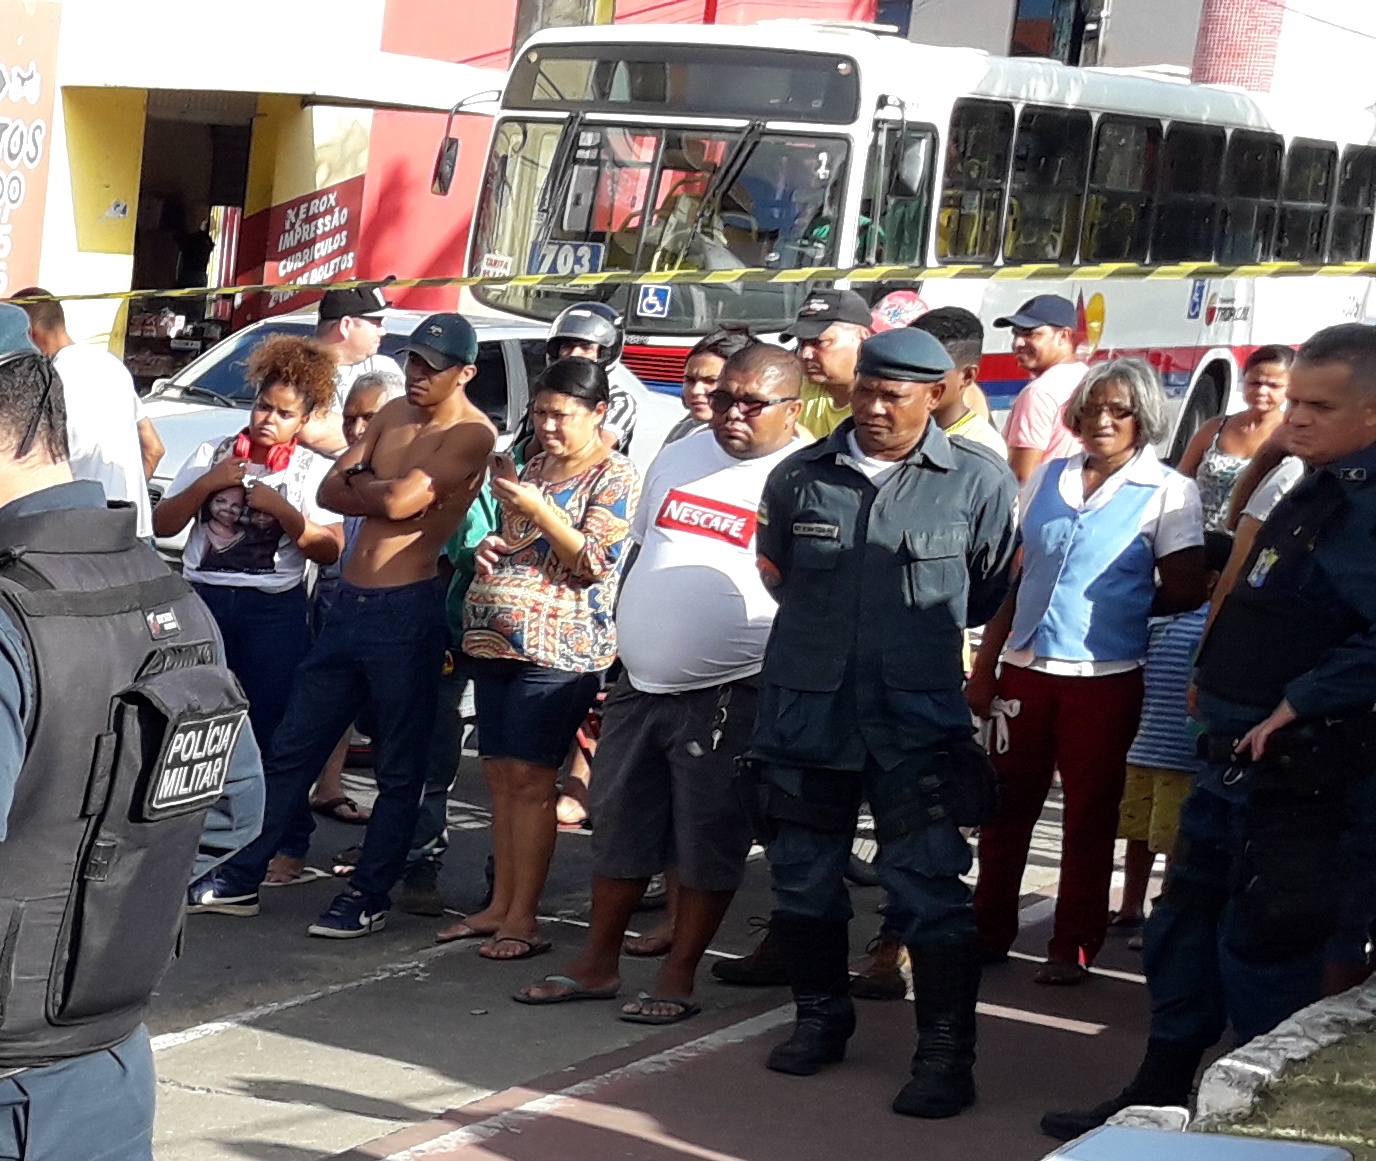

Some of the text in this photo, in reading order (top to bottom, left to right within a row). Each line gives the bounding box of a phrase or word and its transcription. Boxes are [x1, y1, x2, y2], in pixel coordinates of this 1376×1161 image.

[278, 206, 348, 252] IMPRESSÃO
[285, 191, 337, 229] XEROX
[310, 252, 355, 285] BOLETOS
[540, 244, 592, 275] 703
[662, 499, 746, 538] NESCAFÉ
[168, 720, 233, 763] POLÍCIA
[158, 757, 223, 800] MILITAR
